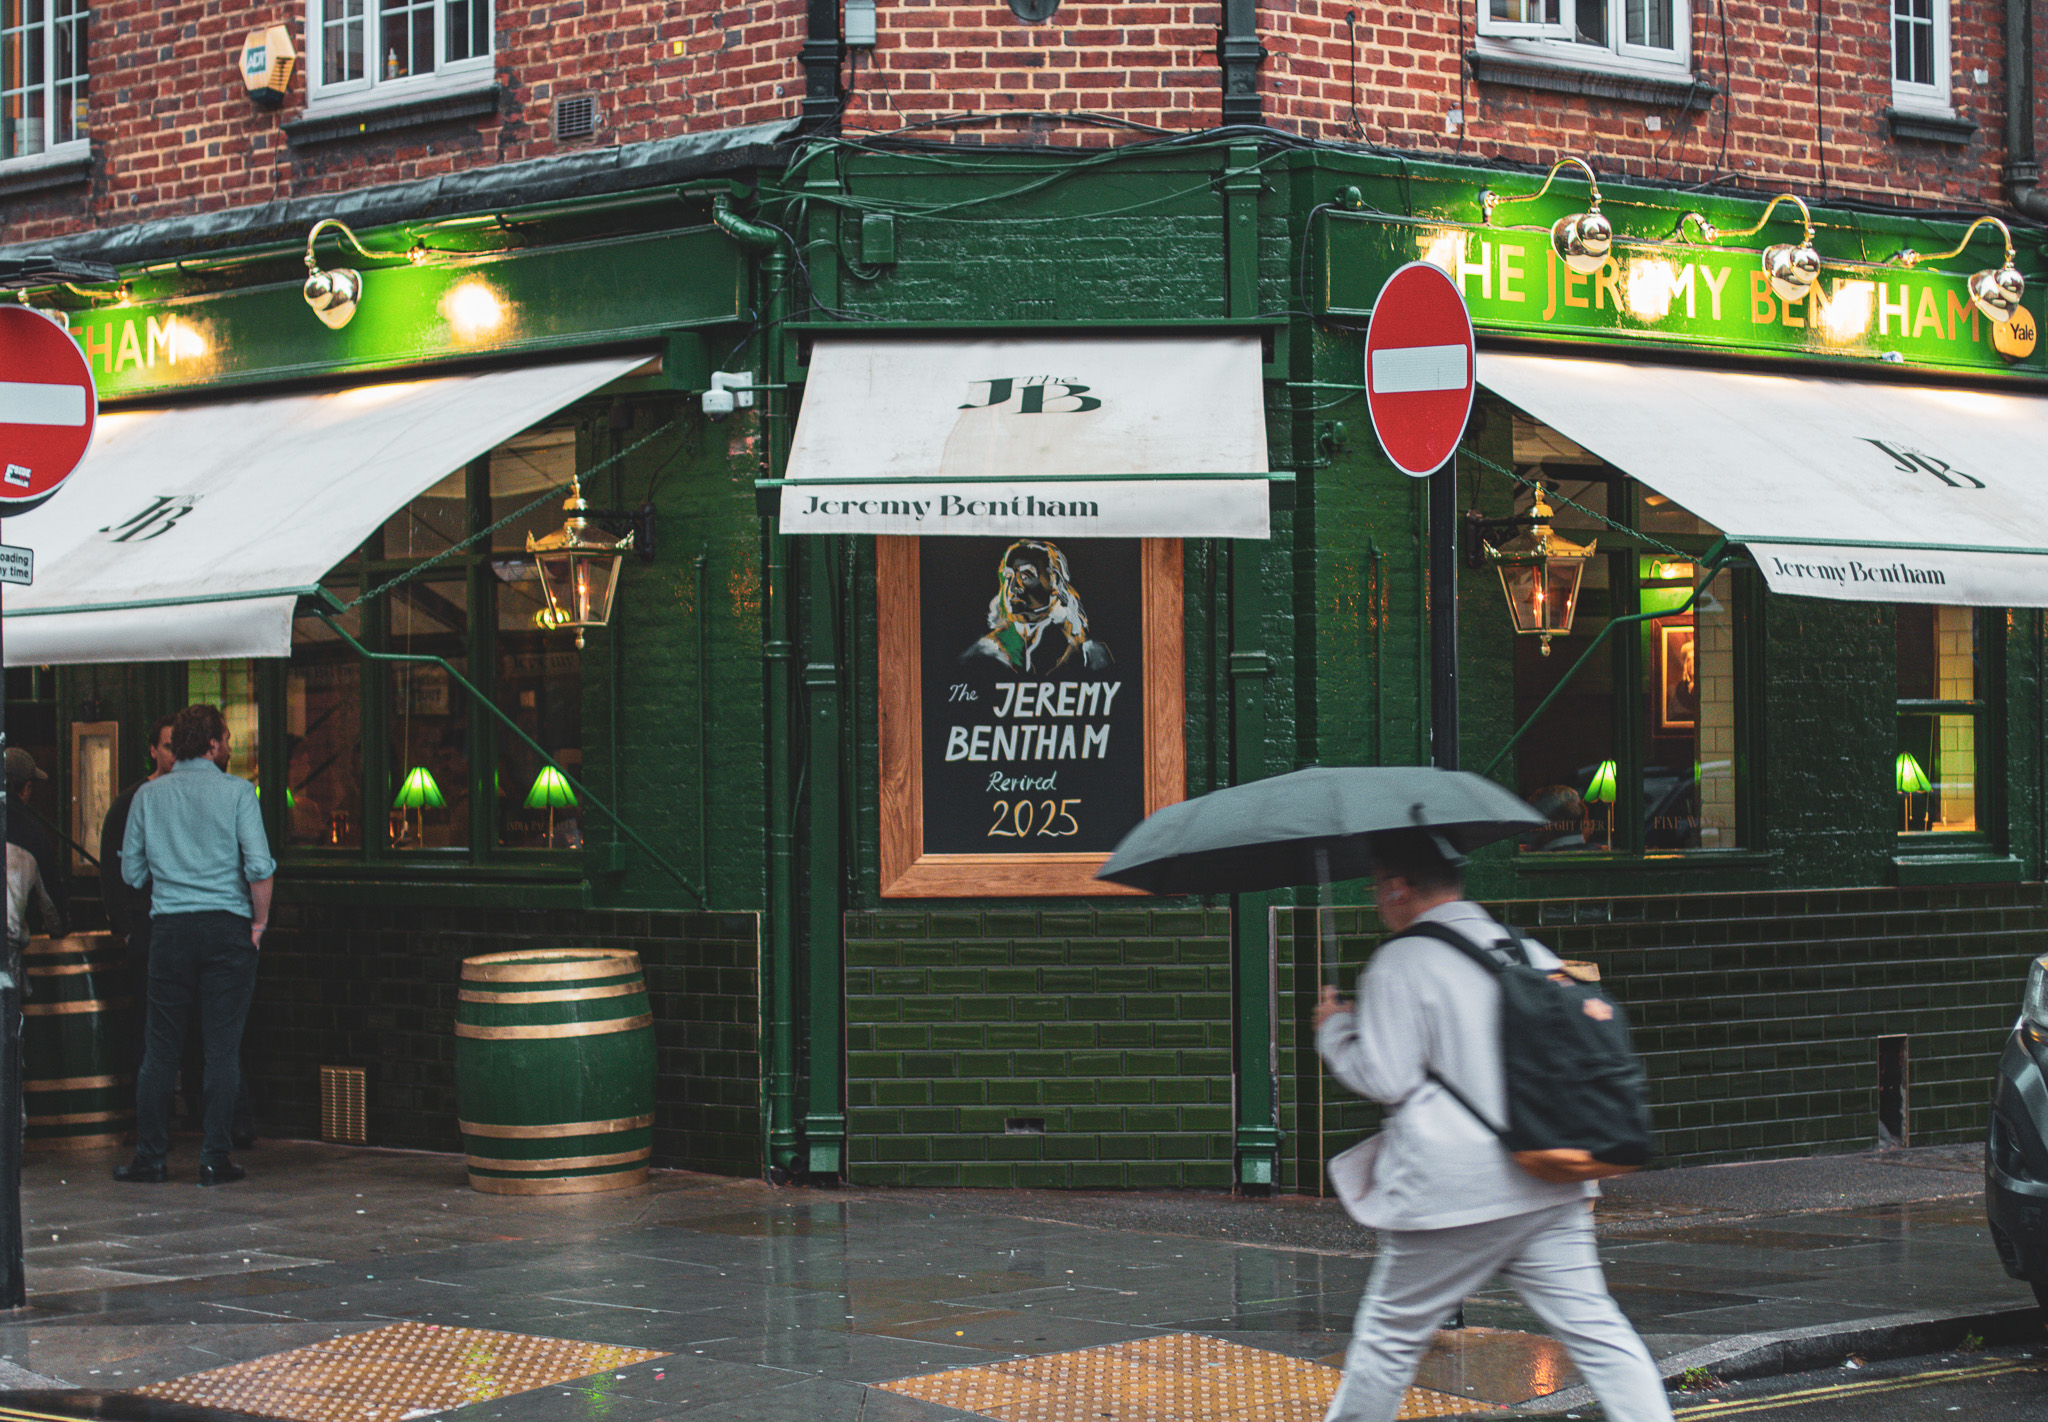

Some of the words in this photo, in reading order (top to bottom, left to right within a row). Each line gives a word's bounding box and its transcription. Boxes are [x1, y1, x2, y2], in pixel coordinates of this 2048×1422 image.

[247, 50, 266, 69] ADT
[2010, 322, 2035, 341] Yale
[1021, 374, 1078, 385] The
[957, 378, 1102, 414] JB
[802, 496, 931, 521] Jeremy
[939, 495, 1099, 517] Bentham
[10, 566, 29, 578] time
[1771, 556, 1846, 587] Jeremy
[1848, 560, 1946, 585] Bentham
[949, 683, 979, 702] The
[992, 681, 1121, 718] JEREMY
[945, 724, 1110, 761] BENTHAM
[987, 798, 1082, 838] 2025
